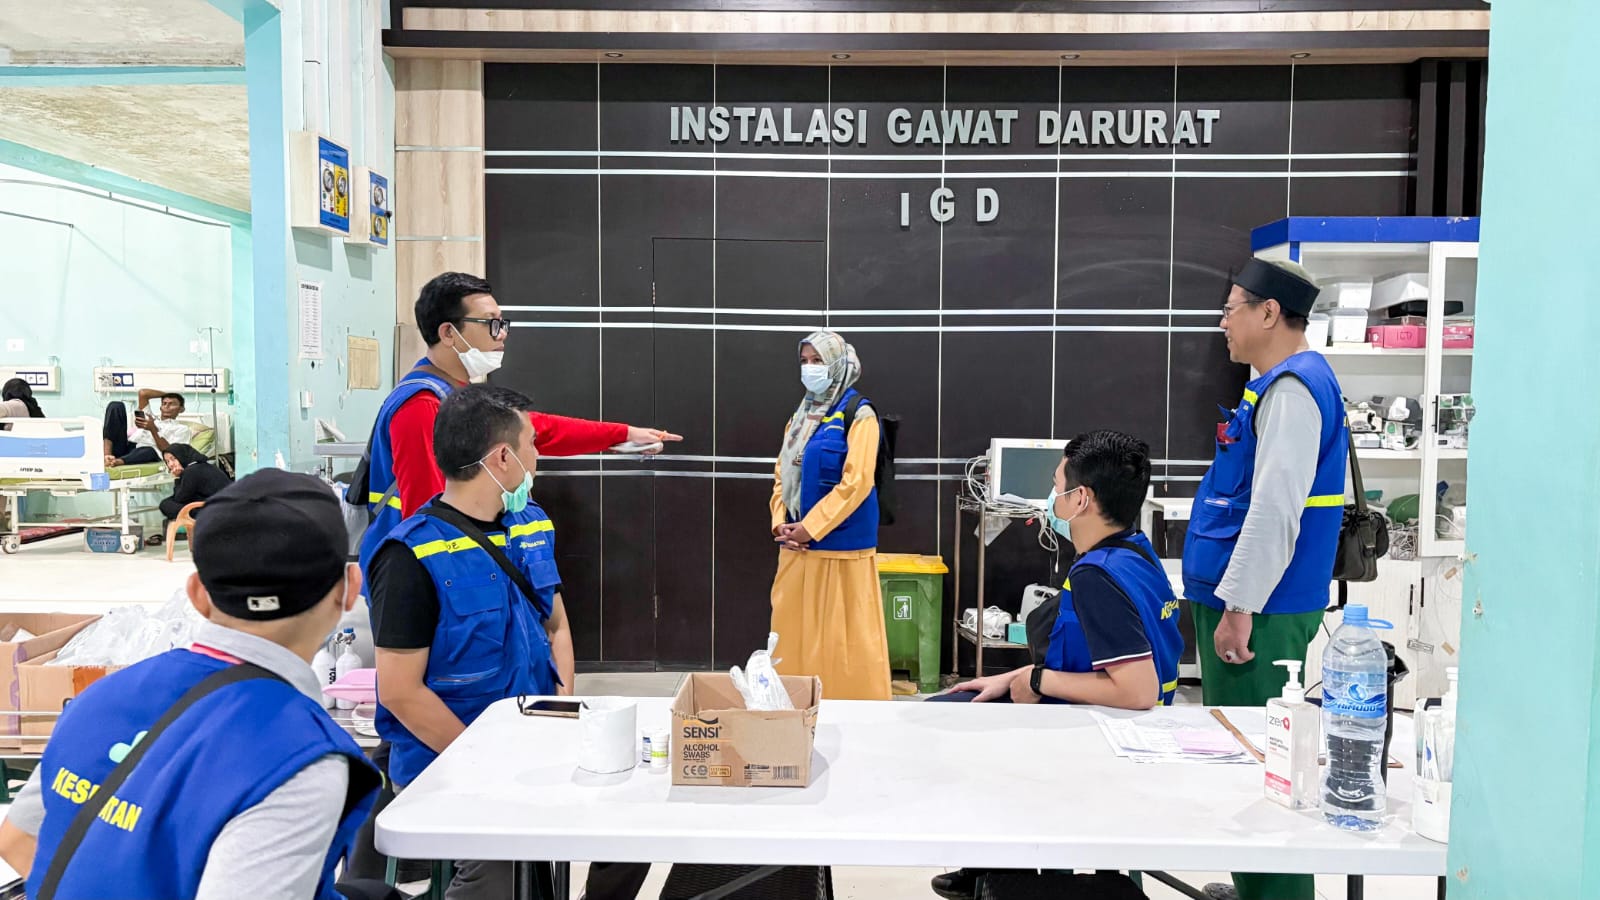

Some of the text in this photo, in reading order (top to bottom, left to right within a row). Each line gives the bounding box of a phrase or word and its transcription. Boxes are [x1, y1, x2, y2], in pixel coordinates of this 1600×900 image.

[670, 106, 1220, 145] INSTALASI GAWAT DARURAT
[683, 726, 719, 739] SENSI
[683, 743, 720, 752] ALCOHOL
[683, 751, 711, 759] SWABS
